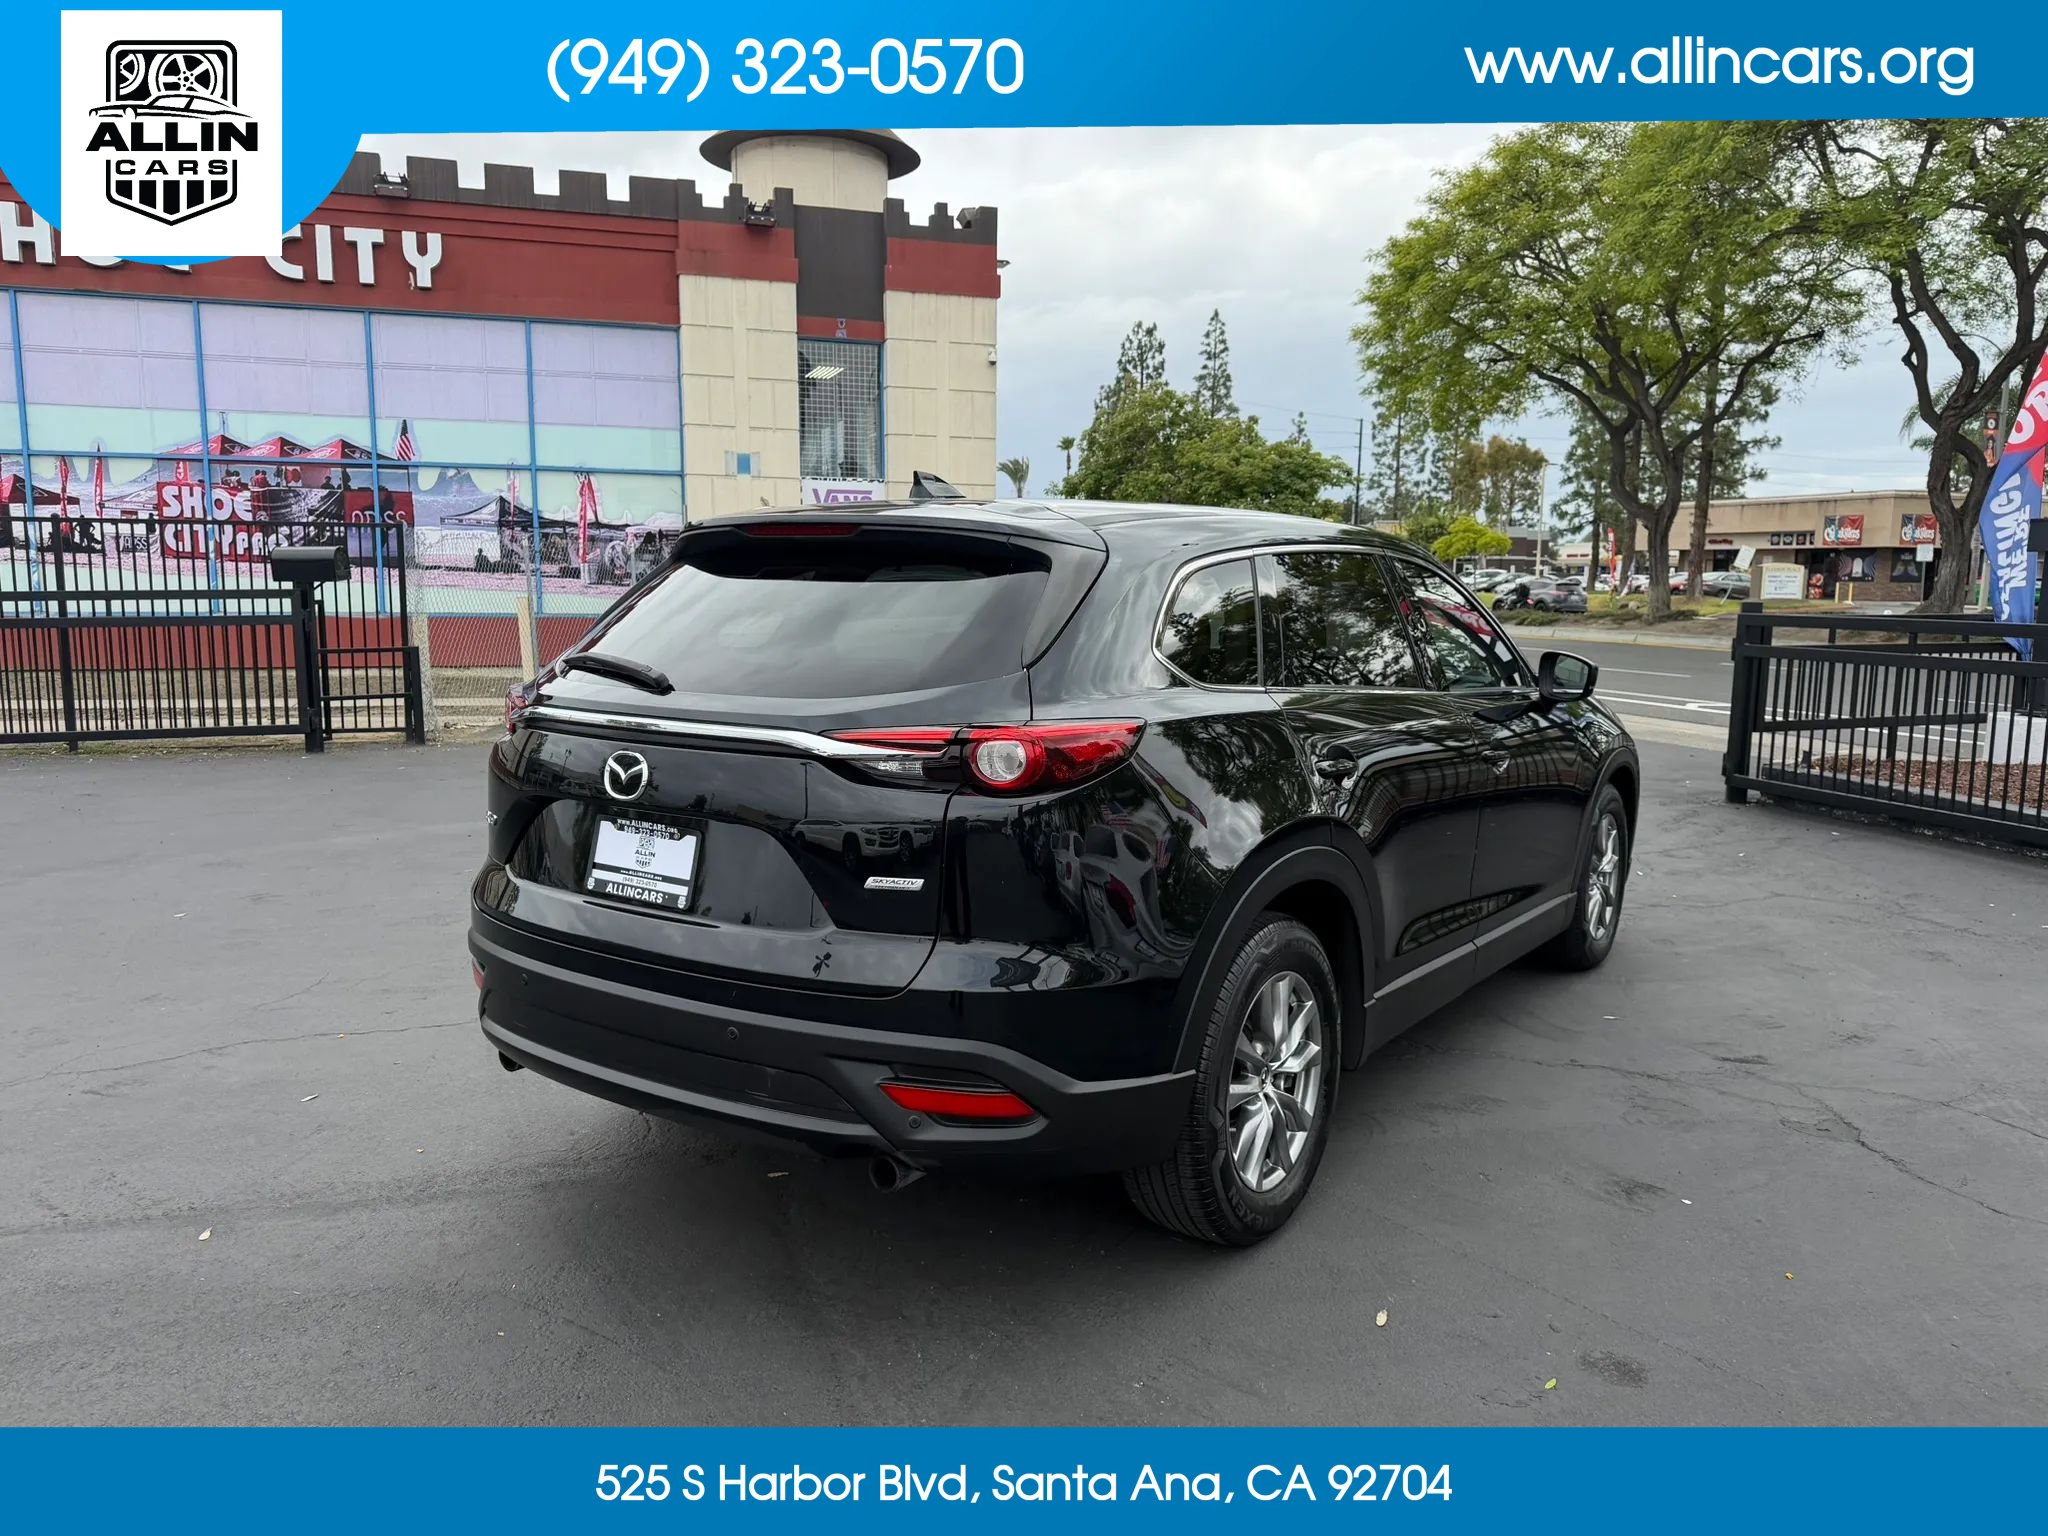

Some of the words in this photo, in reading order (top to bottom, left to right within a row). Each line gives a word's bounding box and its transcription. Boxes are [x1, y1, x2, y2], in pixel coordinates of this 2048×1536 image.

[264, 222, 442, 289] CITY
[161, 485, 254, 521] SHOE
[605, 882, 664, 903] ALLINCARS
[871, 878, 919, 886] SKYACTIV
